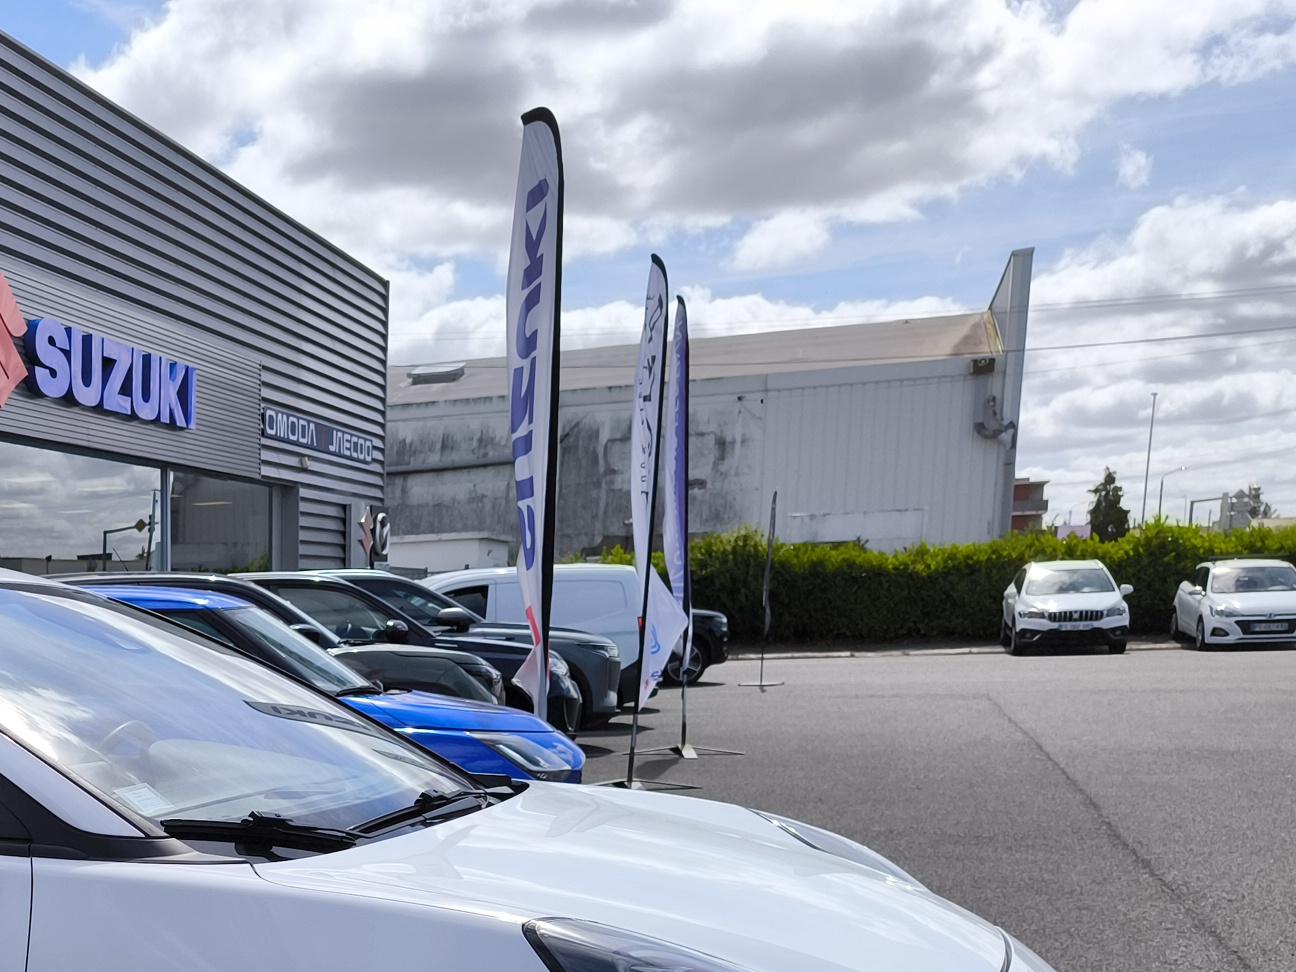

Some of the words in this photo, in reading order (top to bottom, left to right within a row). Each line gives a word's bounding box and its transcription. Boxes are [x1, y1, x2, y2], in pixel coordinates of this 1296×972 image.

[31, 316, 197, 432] SUZUKI
[265, 409, 317, 447] OMODA
[328, 430, 373, 462] JAECOO
